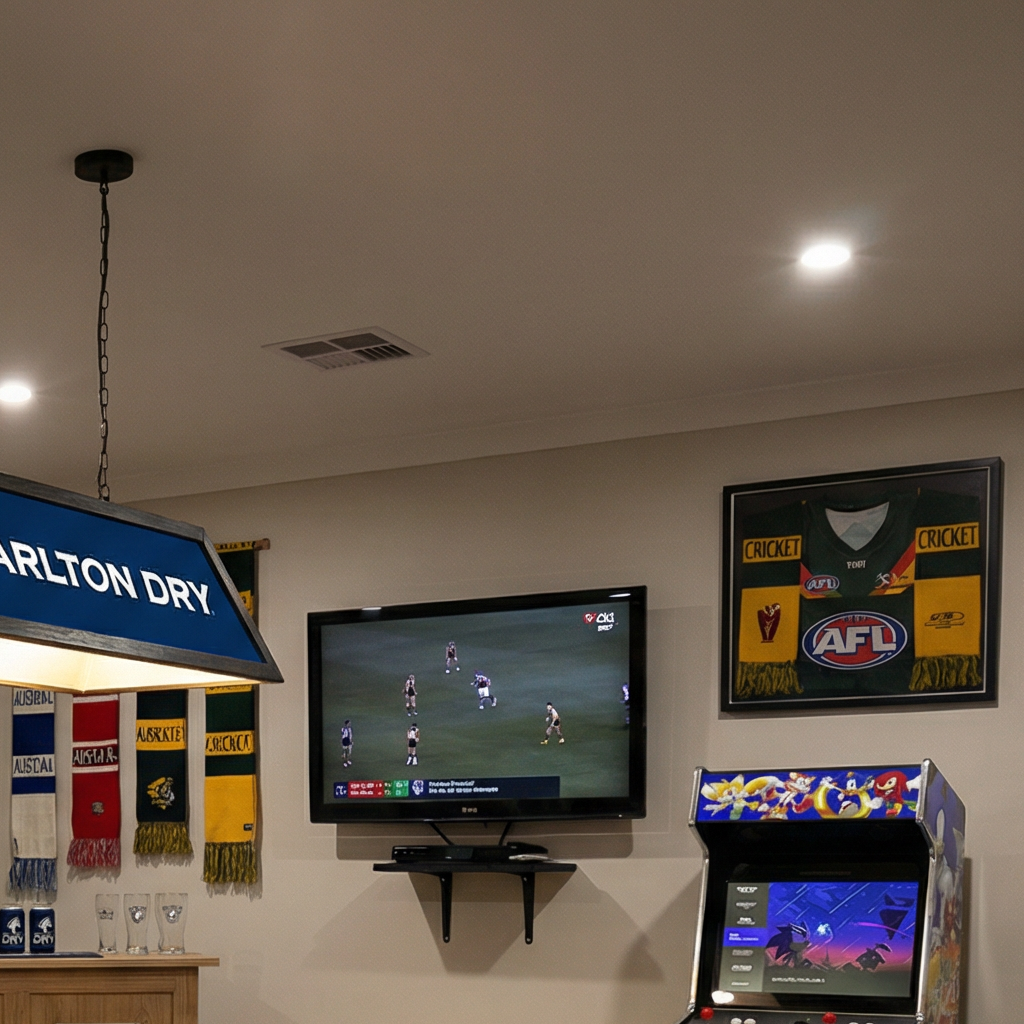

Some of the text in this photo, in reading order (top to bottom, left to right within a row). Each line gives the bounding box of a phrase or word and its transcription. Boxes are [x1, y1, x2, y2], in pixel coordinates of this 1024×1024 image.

[744, 538, 800, 559] CRICKET
[918, 526, 978, 549] CRICKET
[139, 569, 212, 616] DRY
[812, 625, 897, 655] AFL
